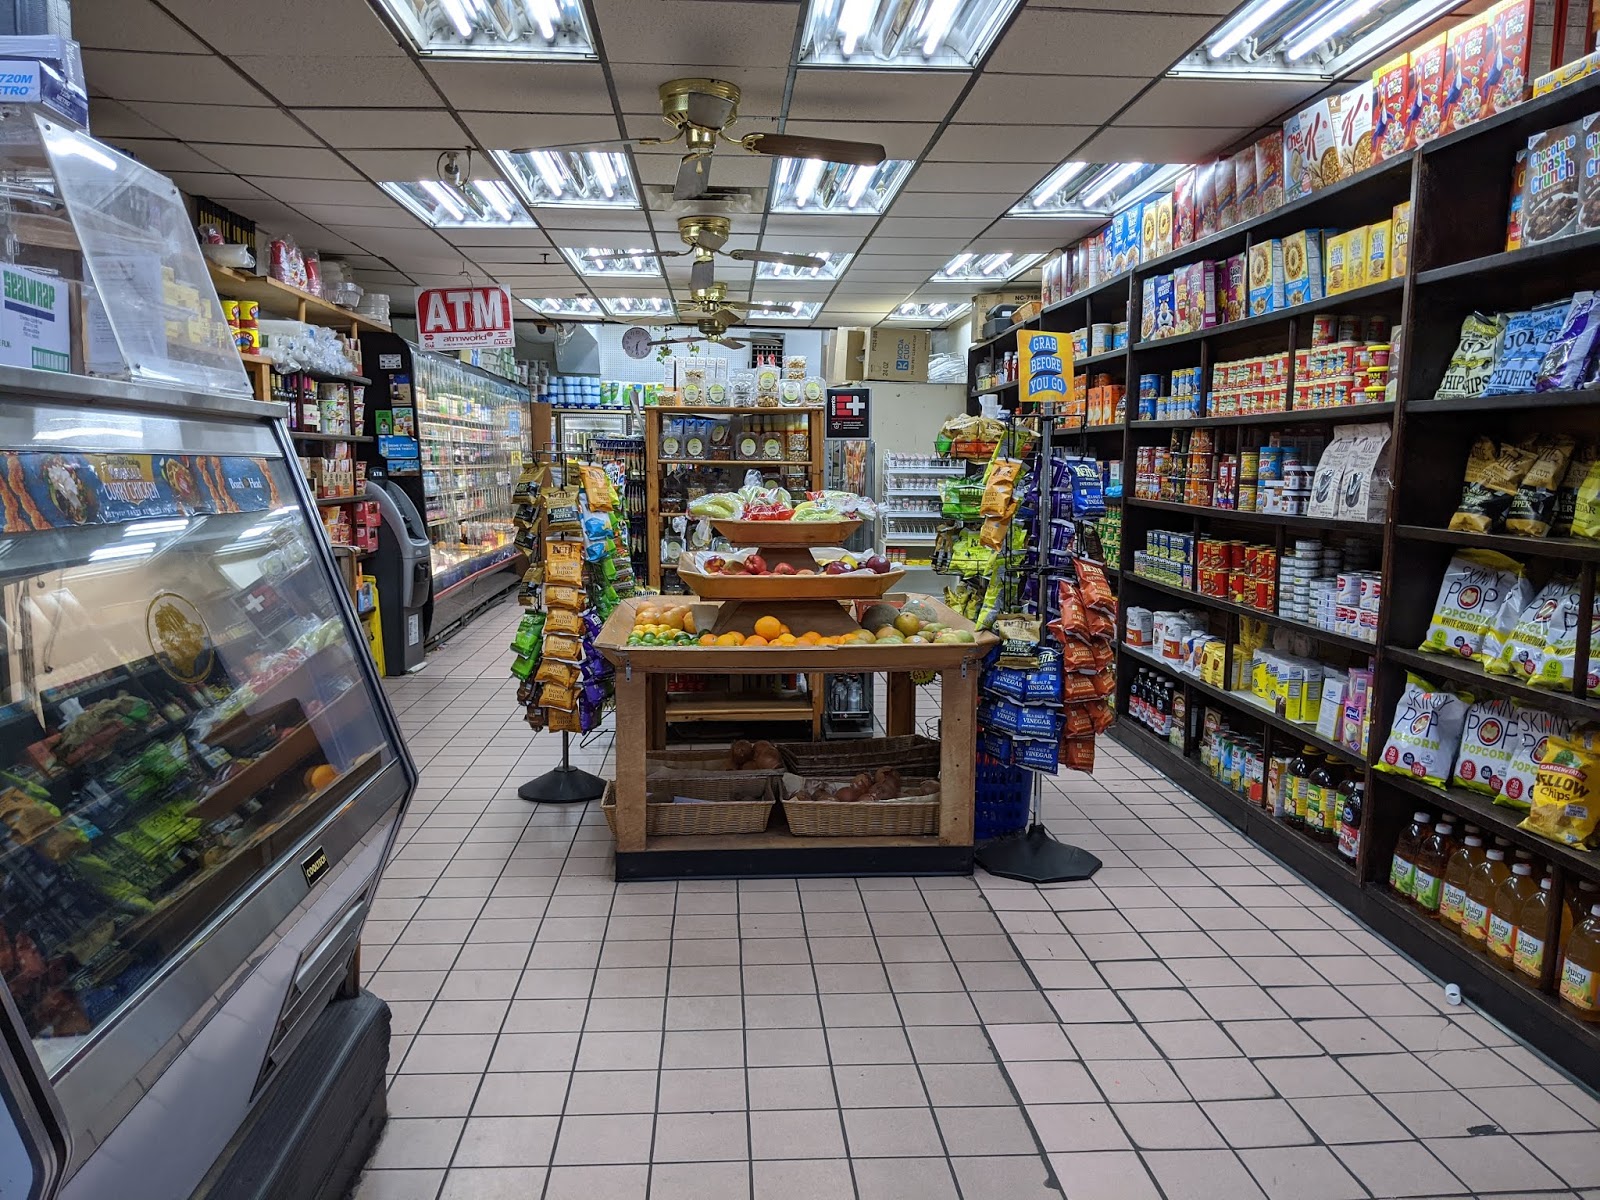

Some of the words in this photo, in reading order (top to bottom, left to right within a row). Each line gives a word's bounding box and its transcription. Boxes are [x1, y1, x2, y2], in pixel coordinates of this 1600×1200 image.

[0, 86, 28, 95] TRO
[1531, 134, 1576, 168] Chocolate
[1537, 150, 1566, 176] Toast
[1531, 158, 1575, 194] Crunch
[424, 290, 504, 331] ATM
[443, 333, 487, 342] atmworld
[1033, 337, 1057, 350] GRAB
[1030, 357, 1062, 373] BEFORE
[1030, 376, 1049, 393] YOU
[1052, 377, 1063, 392] GO
[103, 482, 127, 502] CURRY
[127, 481, 160, 500] CHICKEN
[1457, 566, 1507, 588] SKINNY
[1443, 581, 1499, 613] POP
[1441, 618, 1456, 628] WHITE
[1456, 620, 1480, 634] CHEDDAR
[996, 676, 1023, 688] VINEGAR
[1406, 689, 1454, 711] SKINNY
[1472, 700, 1515, 718] SKINN
[1395, 707, 1439, 737] POP
[1521, 711, 1578, 737] SKINNY
[1390, 729, 1440, 750] POPCORN
[1025, 750, 1053, 759] VINEGAR
[1388, 748, 1396, 756] 39
[1463, 743, 1512, 760] POPCORN
[1522, 733, 1549, 764] PO
[1464, 763, 1472, 771] 39
[1512, 760, 1539, 776] POPC
[1540, 764, 1565, 774] GARDEN
[1510, 780, 1519, 788] 39
[1535, 773, 1590, 798] YELLOW
[1540, 787, 1570, 801] Chips
[1395, 861, 1408, 875] Juicy
[1416, 873, 1429, 888] Juicy
[1445, 889, 1464, 904] Juicy
[1447, 897, 1460, 906] Juice
[1466, 904, 1483, 918] Juicy
[1466, 912, 1479, 920] Juice
[1490, 920, 1508, 935] Juicy
[1491, 928, 1505, 938] Juice
[1519, 937, 1538, 952] Juicy
[1519, 946, 1535, 956] Juice
[1565, 966, 1586, 983] Juicy
[1566, 975, 1583, 986] Juice
